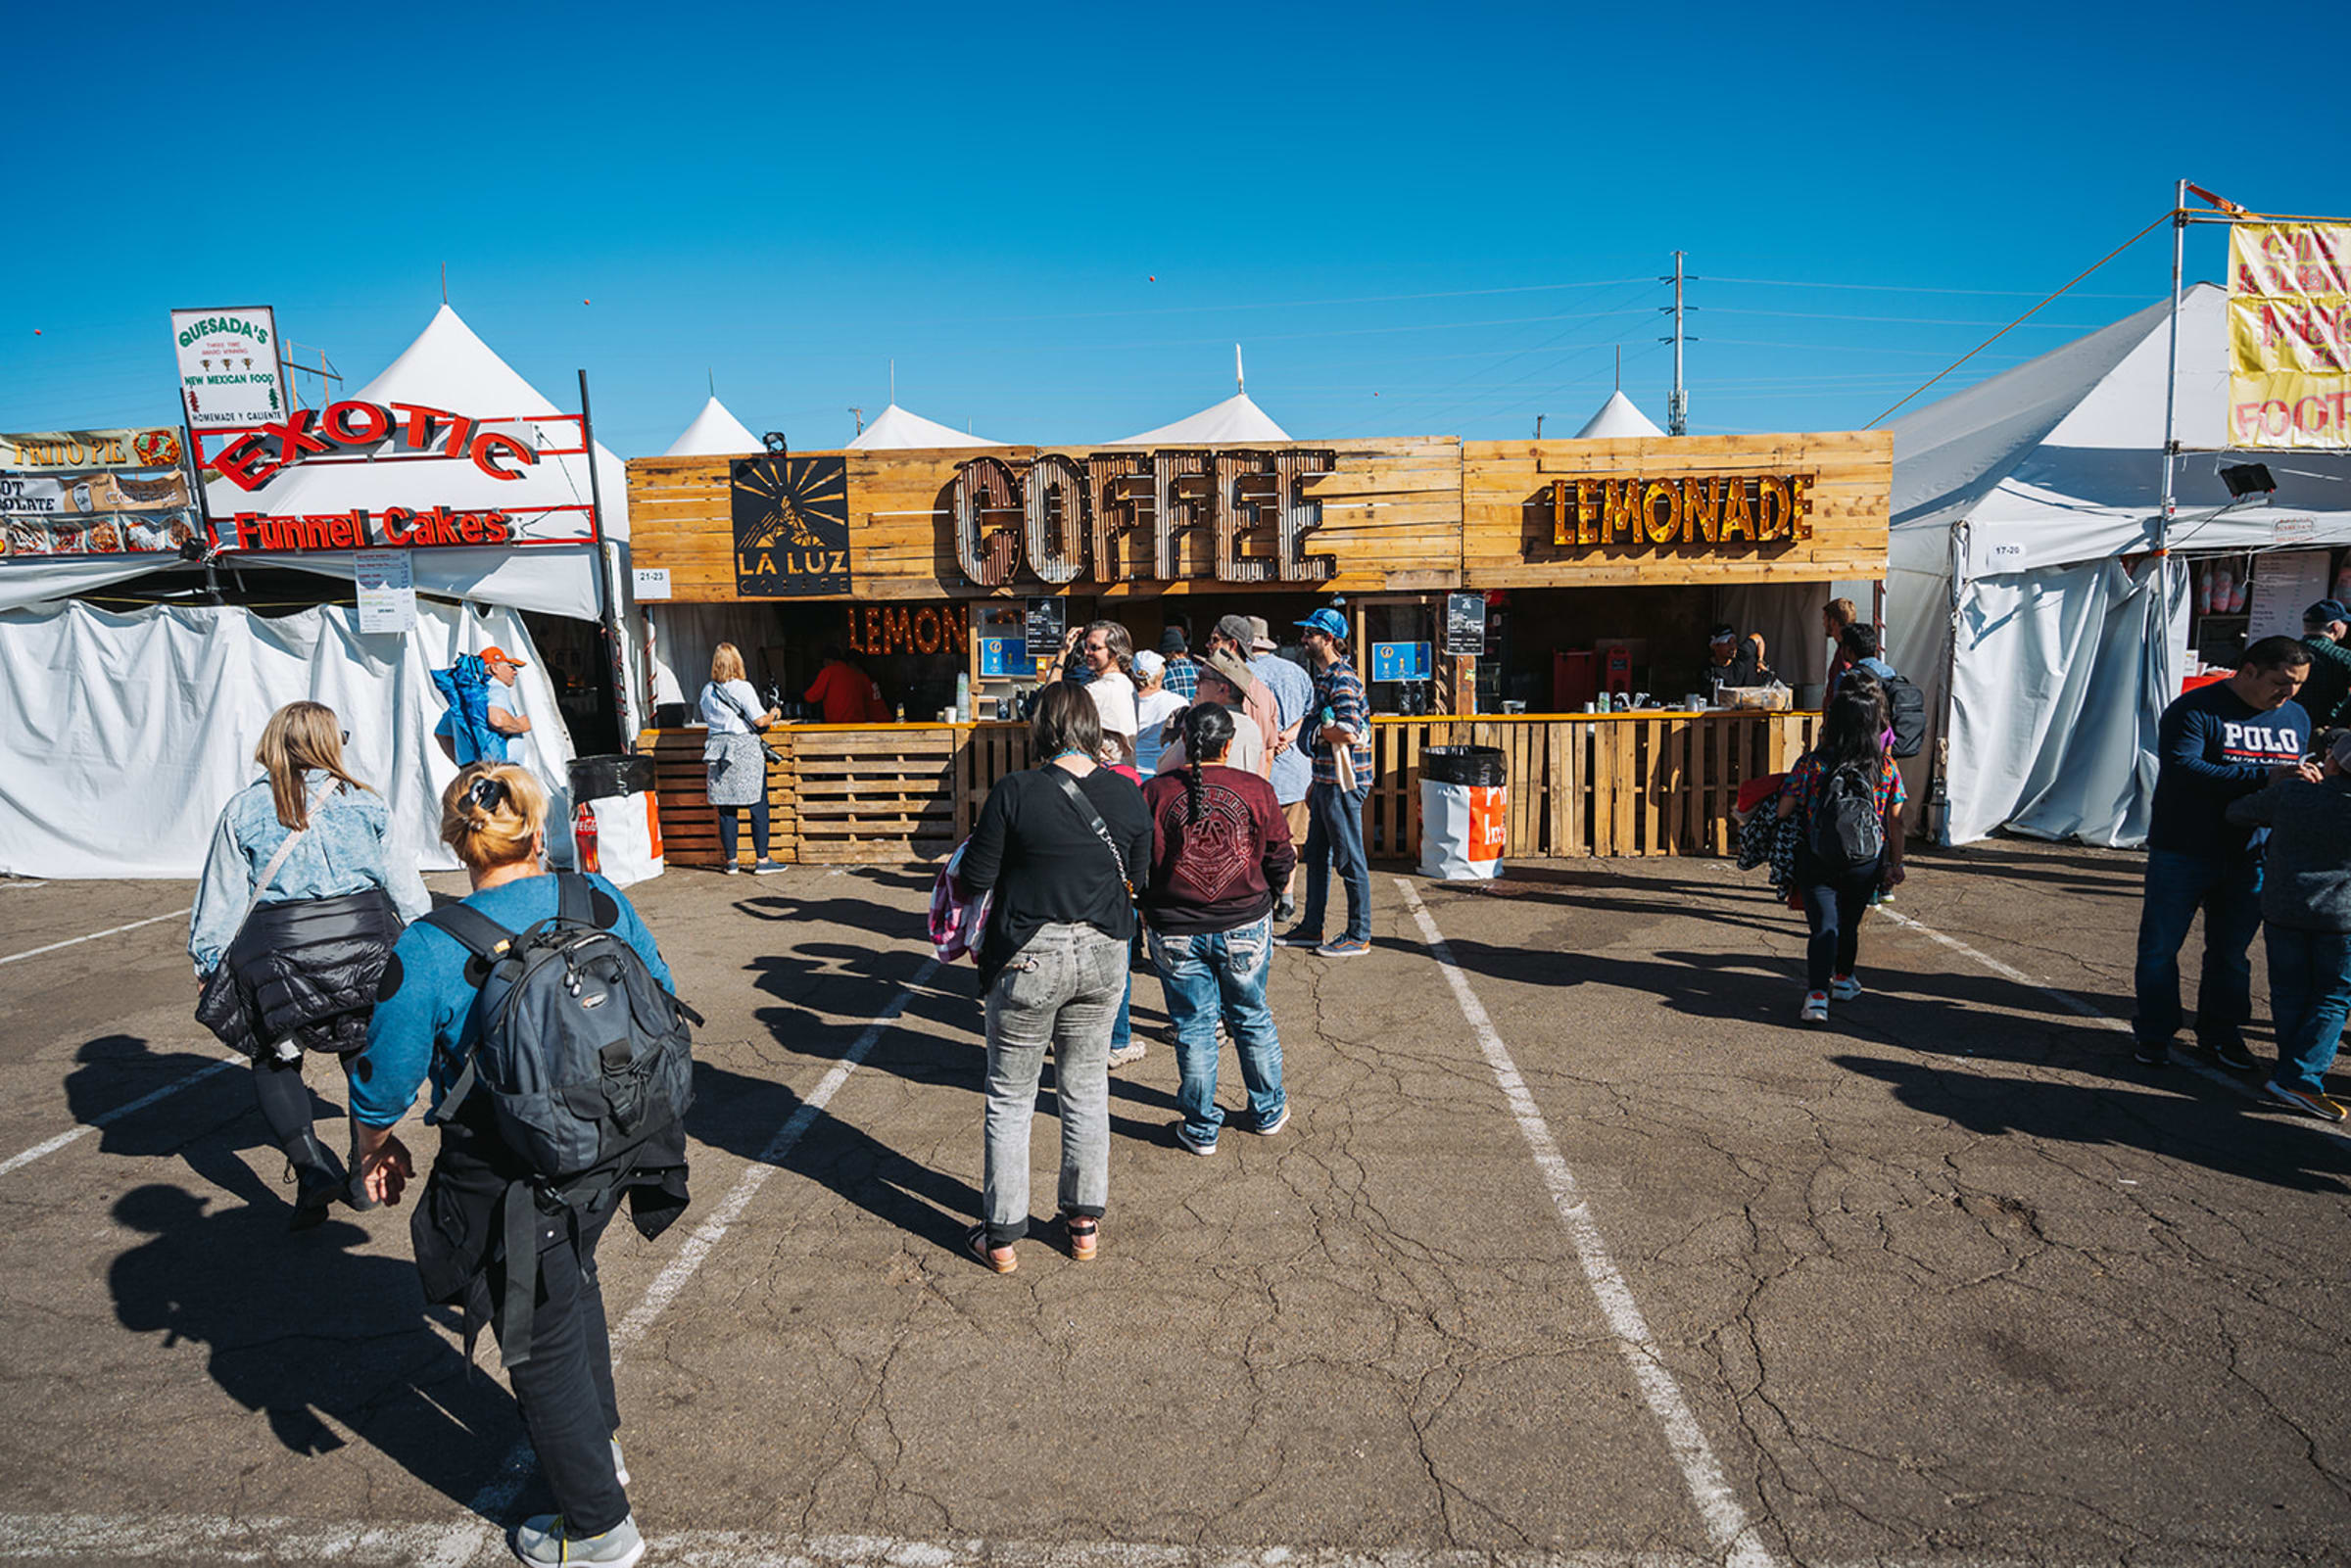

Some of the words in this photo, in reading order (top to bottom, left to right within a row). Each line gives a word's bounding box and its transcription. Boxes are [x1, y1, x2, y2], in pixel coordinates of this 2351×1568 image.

[178, 316, 268, 348] QUESADA'S
[184, 375, 204, 386] NEW
[207, 374, 247, 385] MEXICAN
[250, 373, 275, 384] FOOD
[192, 412, 235, 422] HOMEMADE
[238, 411, 244, 421] Y
[247, 410, 282, 421] CALIENTE
[91, 437, 127, 465] PIE
[211, 401, 541, 492] EXOTIC
[953, 449, 1336, 587] COFFEE
[1552, 475, 1815, 546] LEMONADE
[235, 508, 372, 549] Funnel
[382, 505, 515, 546] Cakes
[640, 572, 664, 582] 21-23
[738, 551, 778, 575] LA
[787, 550, 848, 575] LUZ
[740, 577, 849, 594] COFFEE
[2224, 722, 2299, 753] POLO
